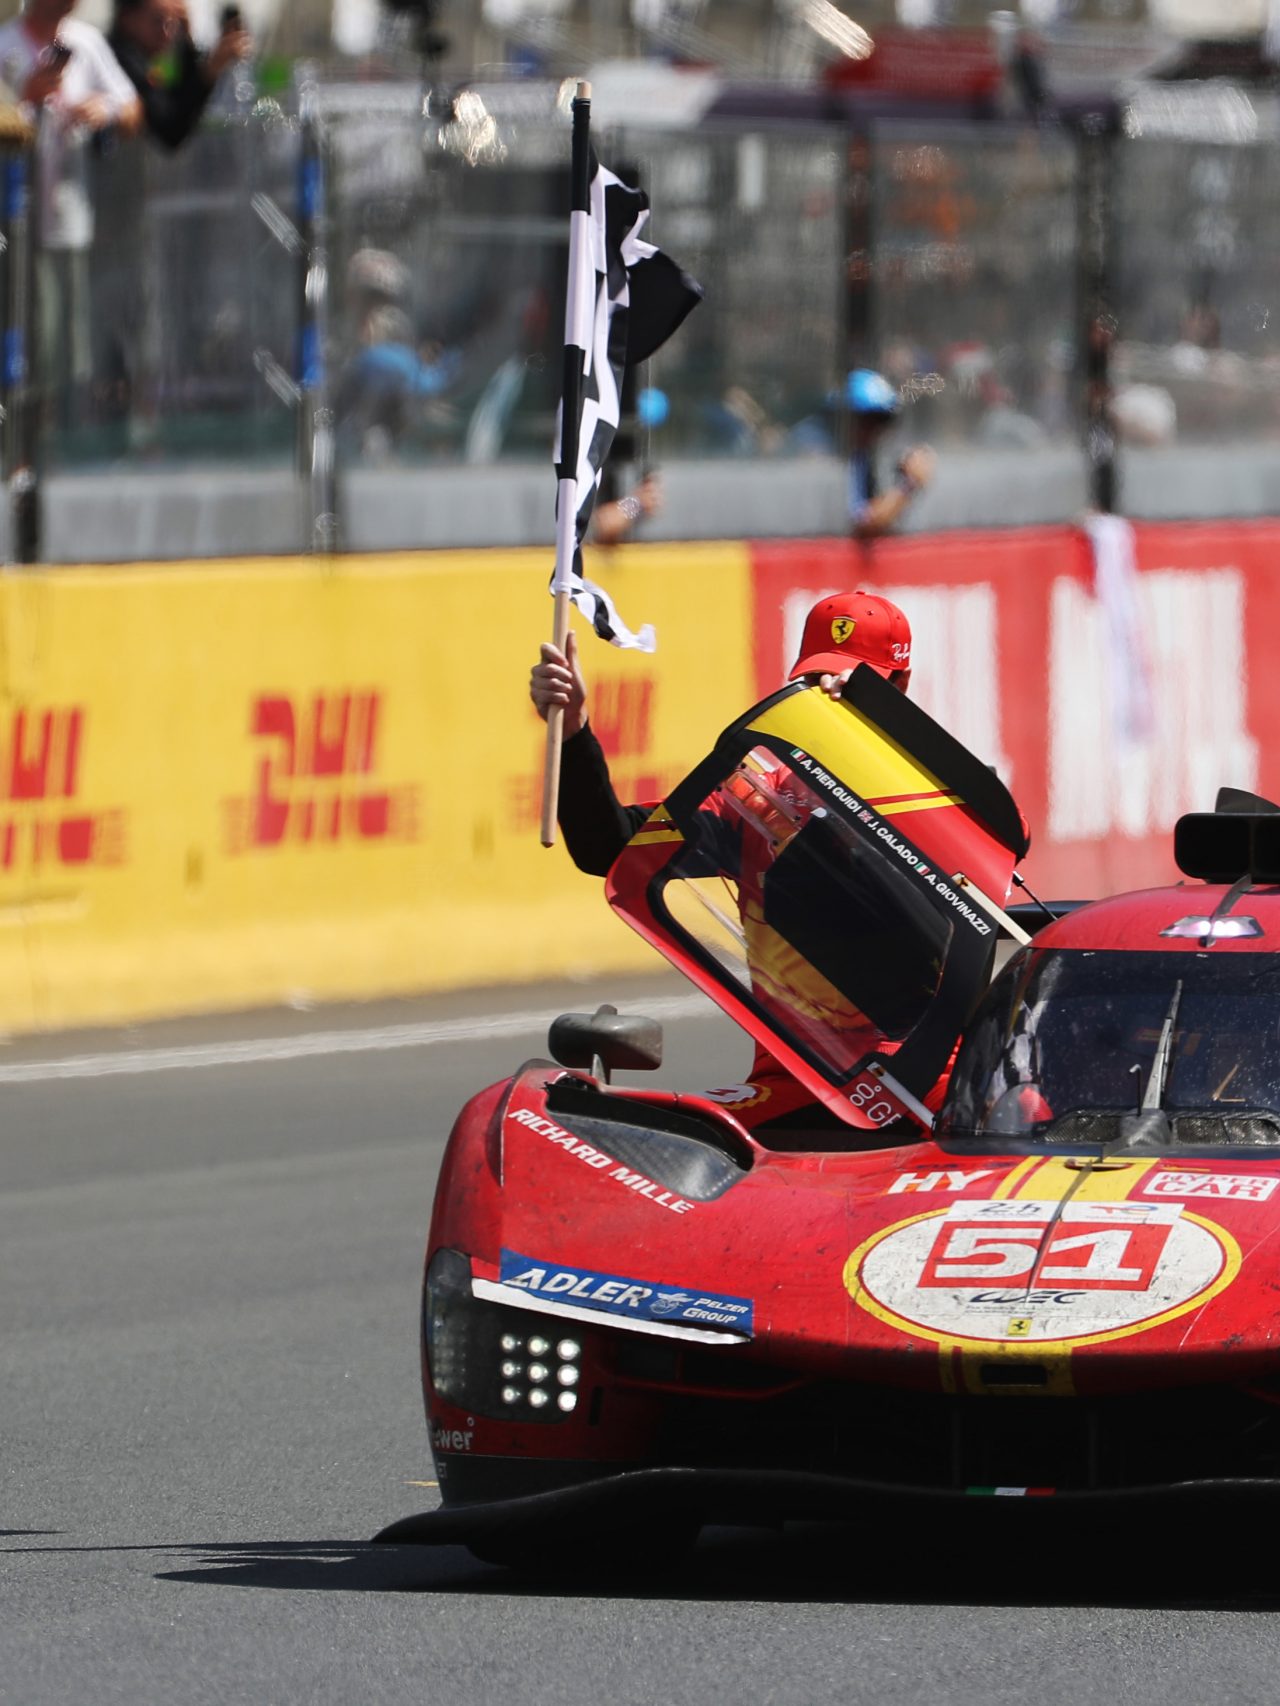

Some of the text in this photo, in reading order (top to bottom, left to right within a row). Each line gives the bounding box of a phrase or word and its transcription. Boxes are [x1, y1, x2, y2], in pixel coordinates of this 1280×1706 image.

[800, 758, 812, 771] A.
[811, 767, 834, 790] PIER
[832, 787, 861, 813] GUIDI
[867, 821, 876, 831] J.
[876, 827, 918, 865] CALADO
[924, 874, 936, 886] A.
[935, 882, 992, 936] GIOVINAZZI
[508, 1108, 695, 1214] RICHARD MILLE
[887, 1170, 995, 1195] HY
[1153, 1182, 1263, 1198] CAR
[934, 1227, 1143, 1282] 51
[502, 1267, 653, 1308] ADLER
[969, 1290, 1087, 1304] WEC
[682, 1307, 738, 1324] GROUP
[693, 1297, 750, 1315] PELZER
